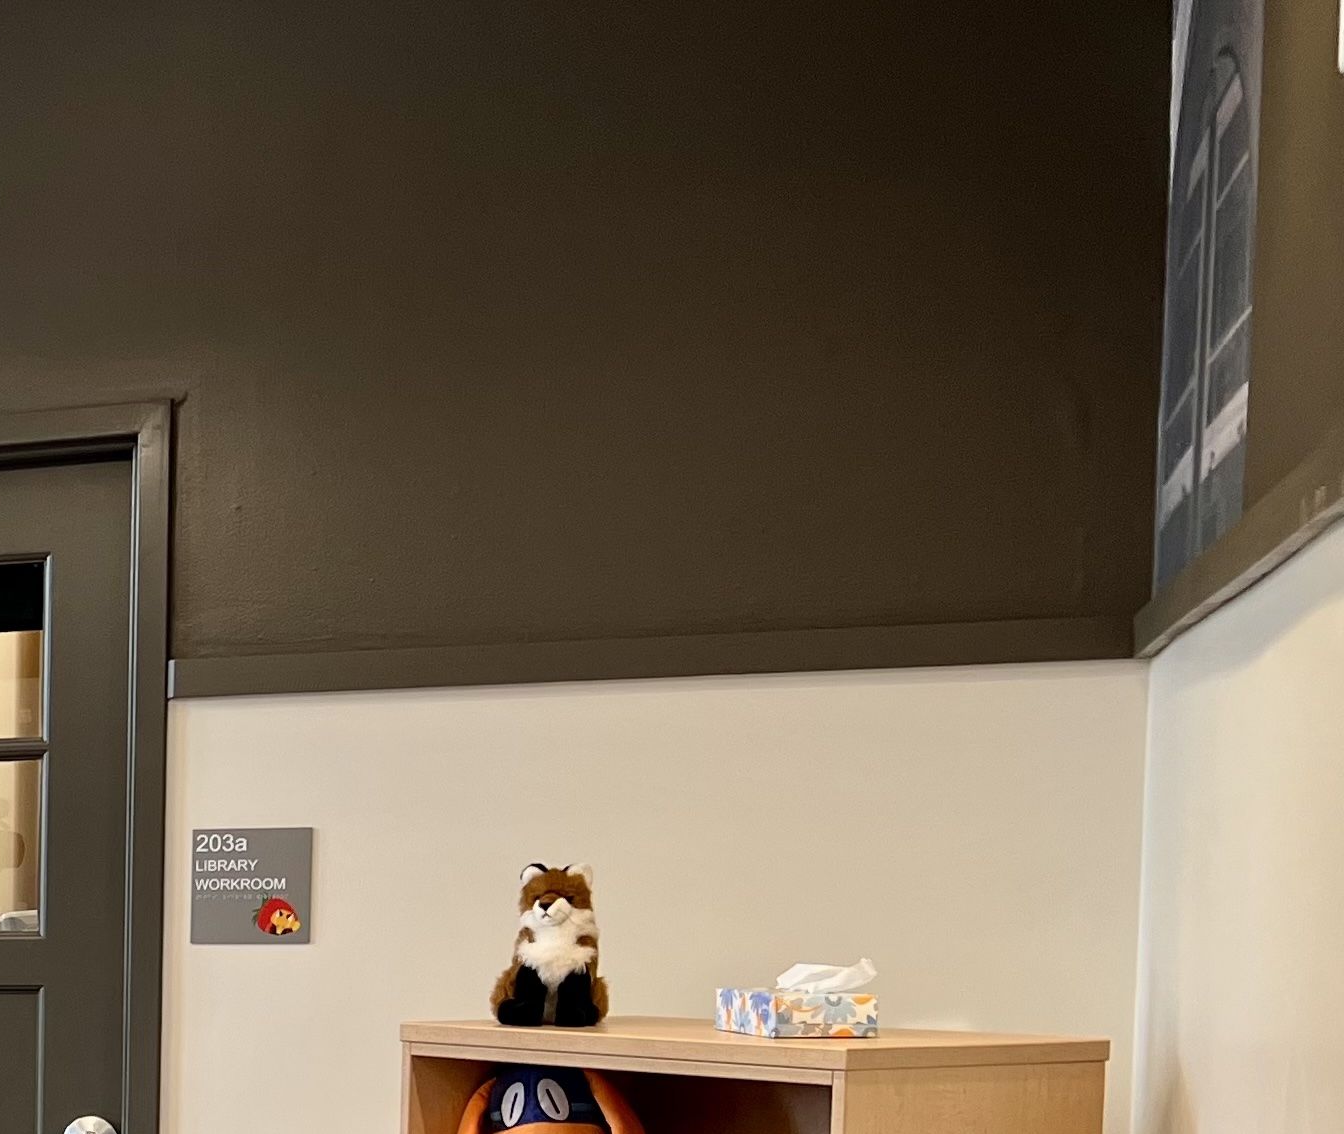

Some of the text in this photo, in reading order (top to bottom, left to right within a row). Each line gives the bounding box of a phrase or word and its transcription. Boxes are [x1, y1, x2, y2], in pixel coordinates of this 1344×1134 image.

[196, 833, 248, 853] 203a
[195, 859, 259, 872] LIBRARY
[195, 877, 287, 891] WORKROOM
